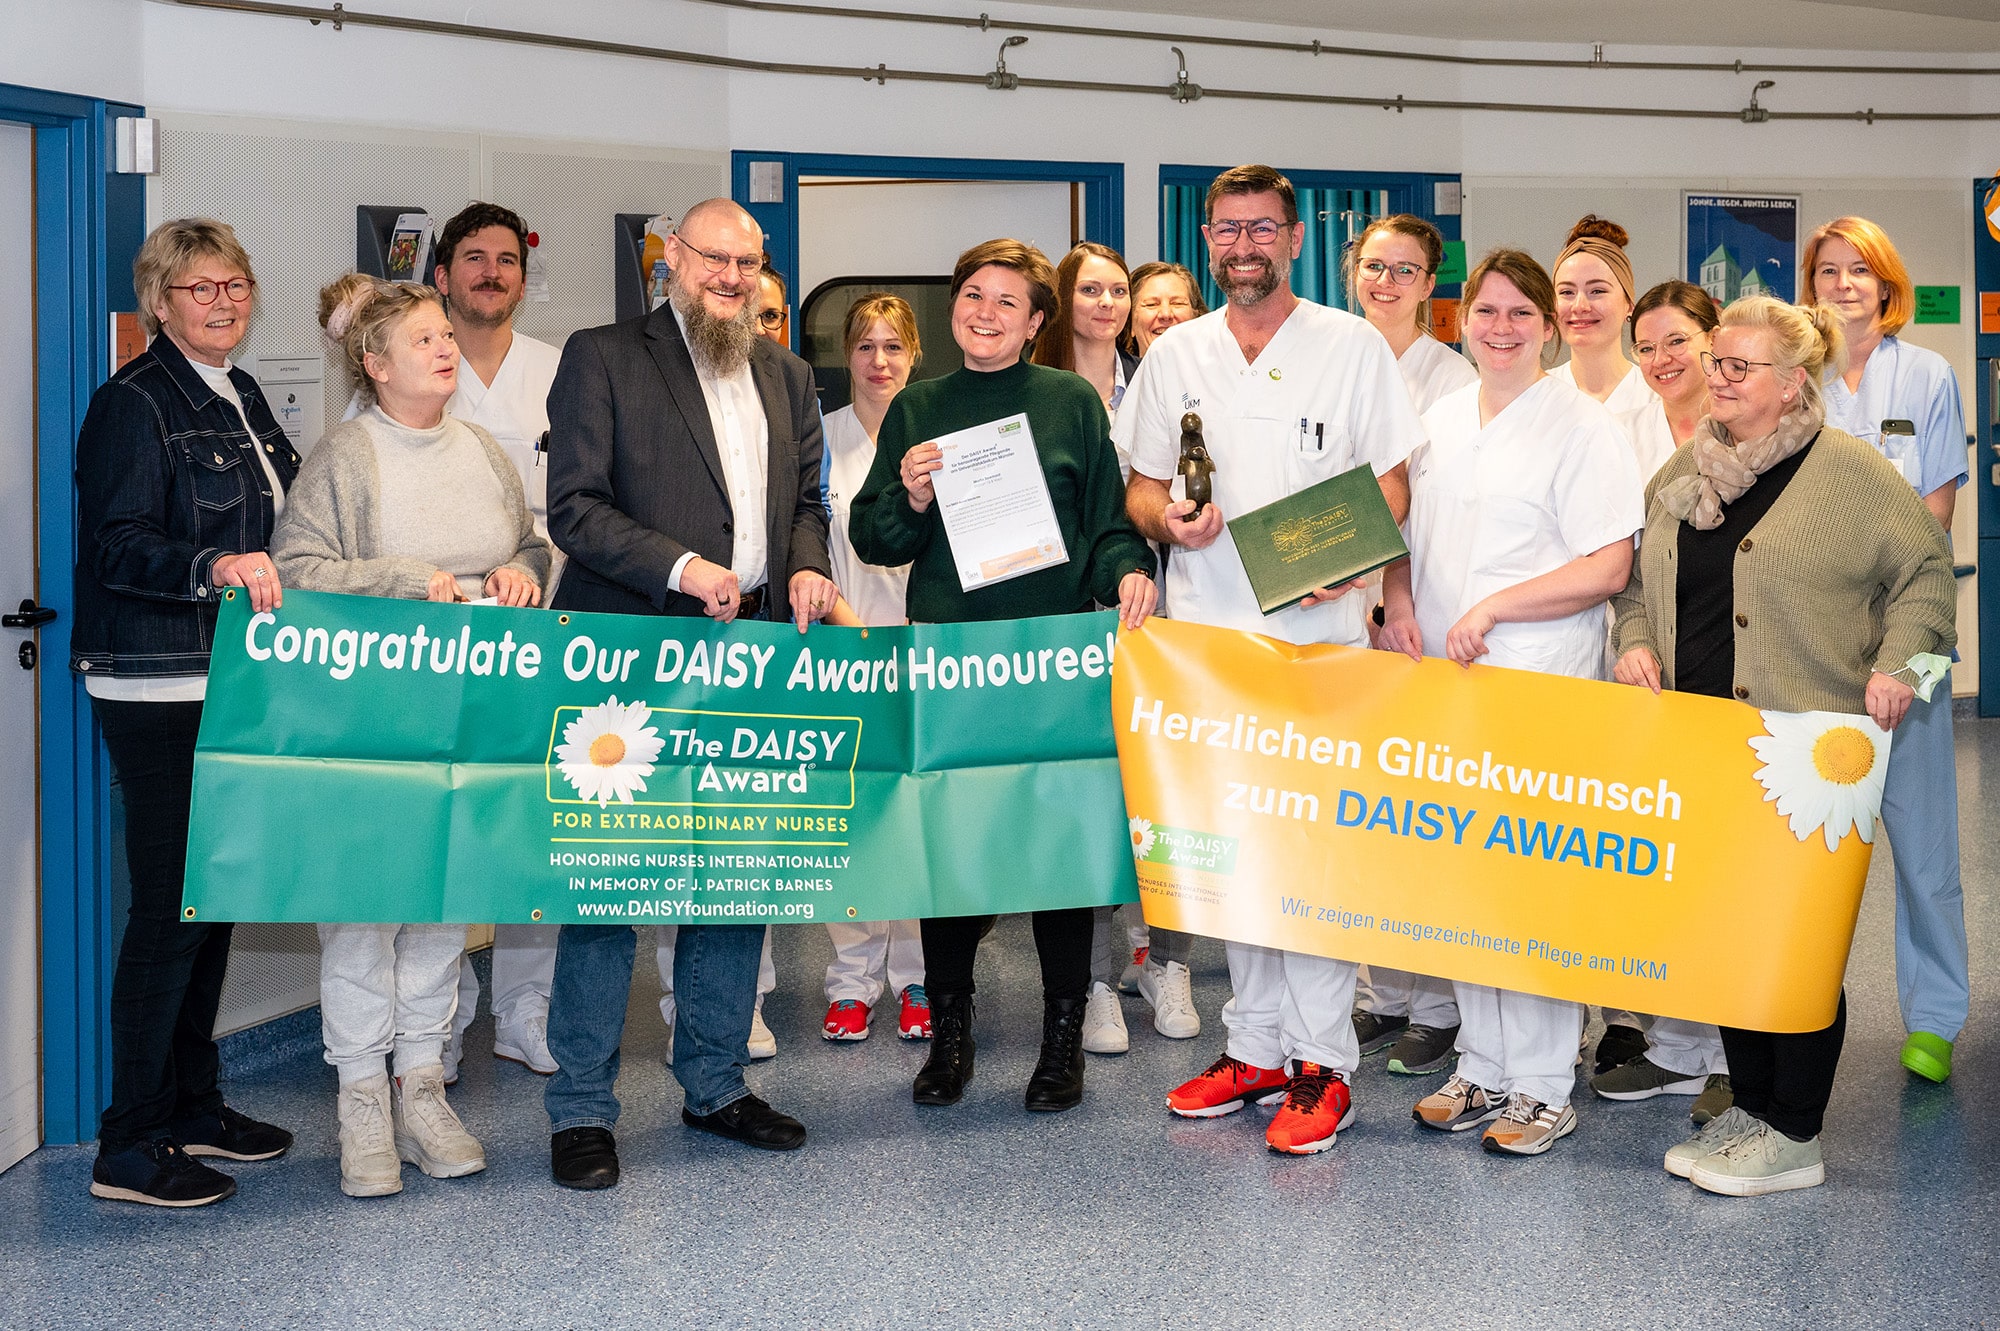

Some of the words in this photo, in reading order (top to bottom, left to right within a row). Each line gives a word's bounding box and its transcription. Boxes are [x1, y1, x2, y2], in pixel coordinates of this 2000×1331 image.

[1185, 399, 1200, 410] UKM
[1322, 508, 1346, 523] DAISY
[246, 612, 542, 680] Congratulate
[564, 635, 640, 683] Our
[654, 639, 776, 688] DAISY
[786, 645, 898, 693] Award
[669, 729, 723, 758] The
[730, 728, 846, 762] DAISY
[1130, 696, 1362, 769] Herzlichen
[1378, 736, 1682, 820] Glückwunsch
[552, 812, 592, 828] FOR
[600, 813, 768, 831] EXTRAORDINARY
[776, 816, 848, 832] NURSES
[1224, 782, 1319, 822] zum
[1336, 789, 1476, 845] DAISY
[1484, 814, 1676, 882] AWARD!
[1158, 832, 1181, 848] The
[1184, 835, 1232, 855] DAISY
[550, 853, 641, 867] HONORING
[646, 854, 705, 868] NURSES
[709, 855, 850, 869] INTERNATIONALLY
[569, 877, 585, 890] IN
[590, 878, 660, 891] MEMORY
[664, 878, 686, 891] OF
[690, 879, 702, 892] J.
[706, 878, 771, 892] PATRICK
[775, 879, 834, 892] BARNES
[1143, 878, 1167, 888] NURSES
[1168, 883, 1228, 898] INTERNATIONALLY
[578, 900, 814, 918] www.DAISYfoundation.org
[1281, 896, 1313, 918] Wir
[1316, 905, 1375, 930] zeigen
[1380, 915, 1521, 955] ausgezeichnete
[1526, 938, 1582, 969] Pflege
[1588, 954, 1615, 972] am
[1622, 957, 1668, 981] UKM
